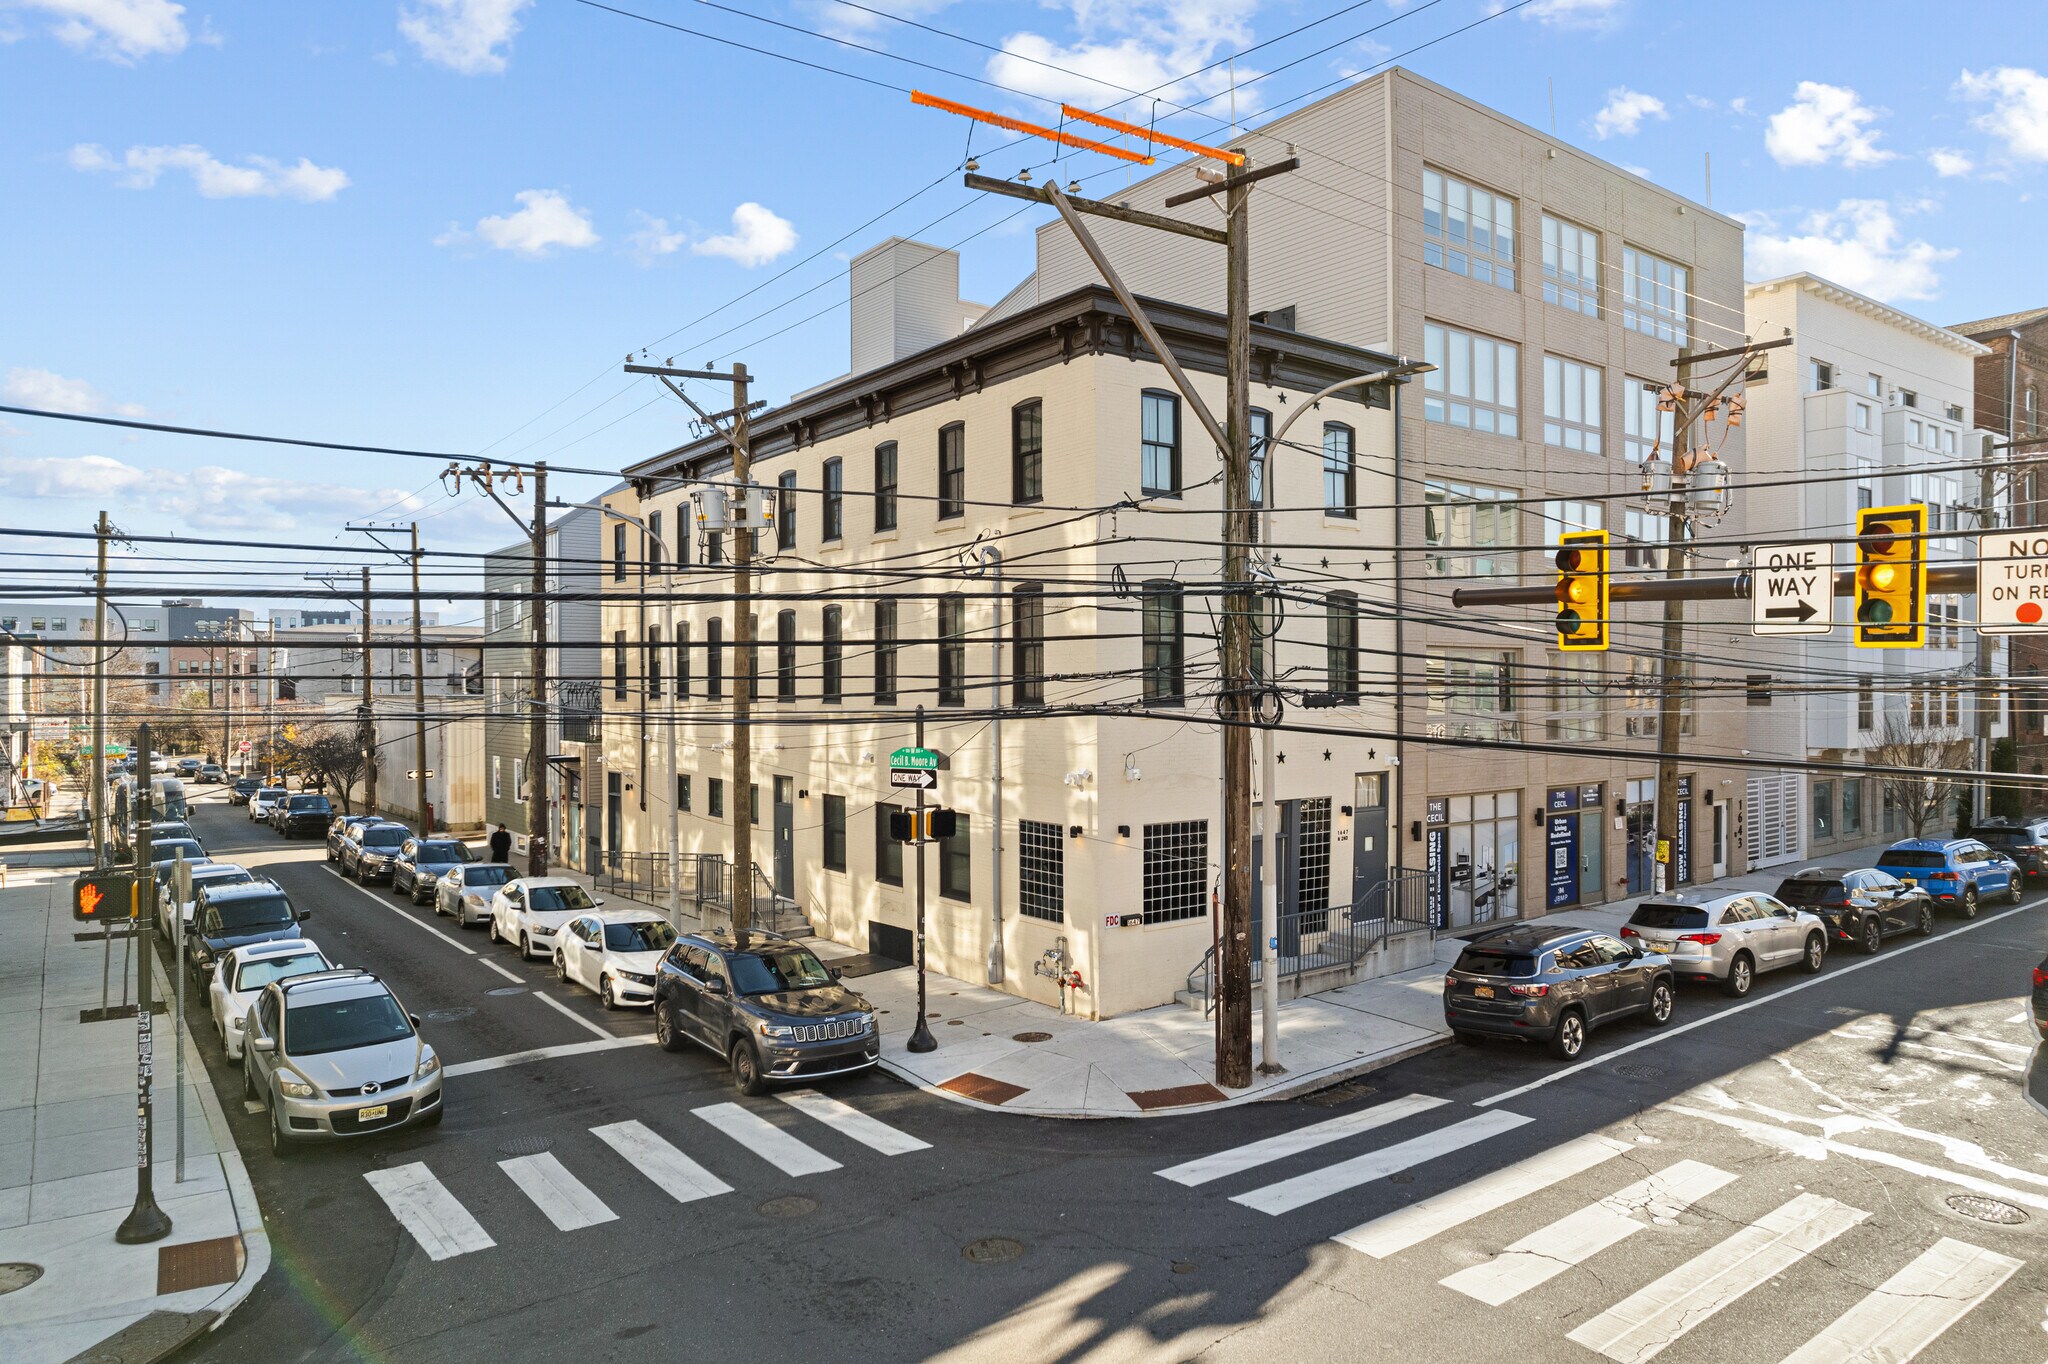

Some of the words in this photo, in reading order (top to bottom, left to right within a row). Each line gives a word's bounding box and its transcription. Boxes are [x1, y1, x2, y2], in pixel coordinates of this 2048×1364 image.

[2010, 539, 2048, 556] NO
[1769, 551, 1817, 572] ONE
[2004, 564, 2048, 579] TUR
[1768, 576, 1817, 597] WAY
[1992, 586, 2018, 600] ON
[891, 755, 904, 766] Cecil
[905, 755, 910, 766] B.
[911, 756, 928, 767] Moore
[929, 757, 937, 767] Av
[894, 774, 905, 782] ONE
[908, 774, 921, 783] WAY
[1556, 791, 1566, 799] THE
[1429, 803, 1441, 811] THE
[1554, 800, 1567, 808] CECIL
[1427, 814, 1444, 823] CECIL
[1105, 915, 1119, 927] FDC
